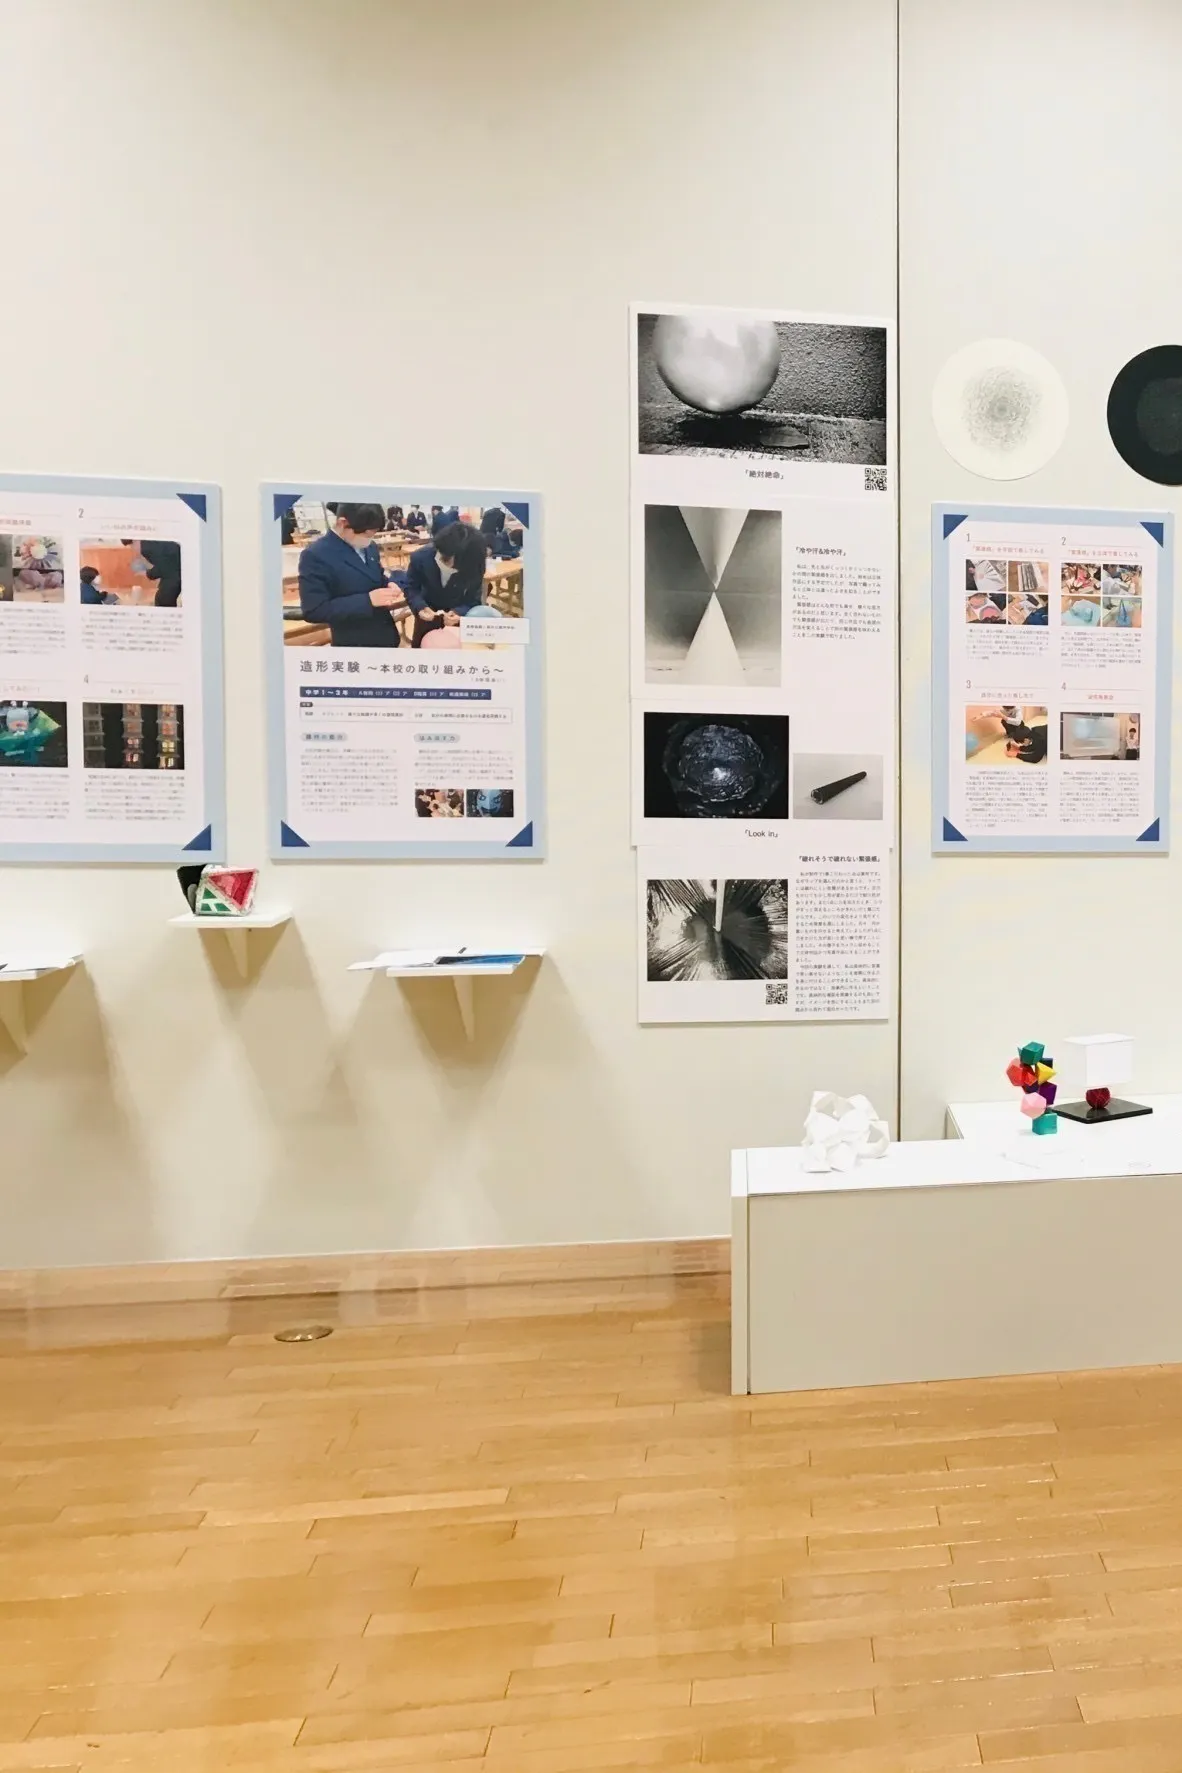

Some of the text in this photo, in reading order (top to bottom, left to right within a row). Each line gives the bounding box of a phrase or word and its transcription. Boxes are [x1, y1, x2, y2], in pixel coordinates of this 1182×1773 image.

[78, 508, 84, 519] 2
[966, 533, 971, 542] 1
[1061, 537, 1067, 545] 2
[299, 660, 361, 673] 造形実験
[966, 680, 971, 689] 3
[1061, 682, 1067, 691] 4
